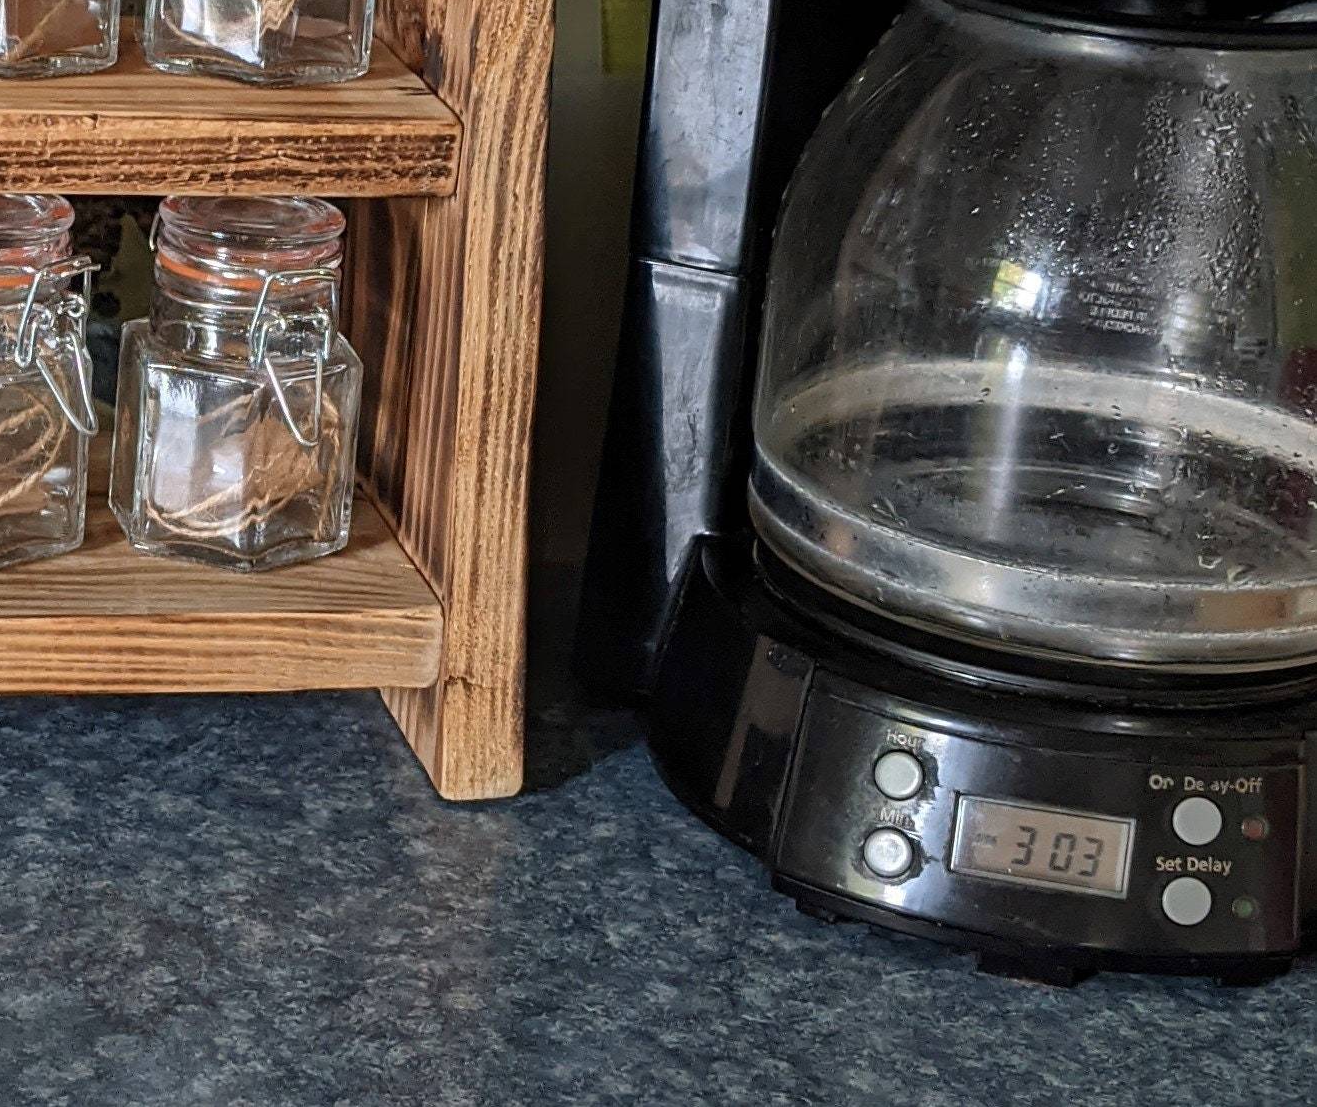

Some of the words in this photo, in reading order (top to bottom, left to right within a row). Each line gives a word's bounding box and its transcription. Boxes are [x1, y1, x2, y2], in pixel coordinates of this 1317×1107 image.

[1184, 776, 1263, 795] Deay-Off
[1155, 856, 1183, 872] Set
[1186, 856, 1233, 876] Delay
